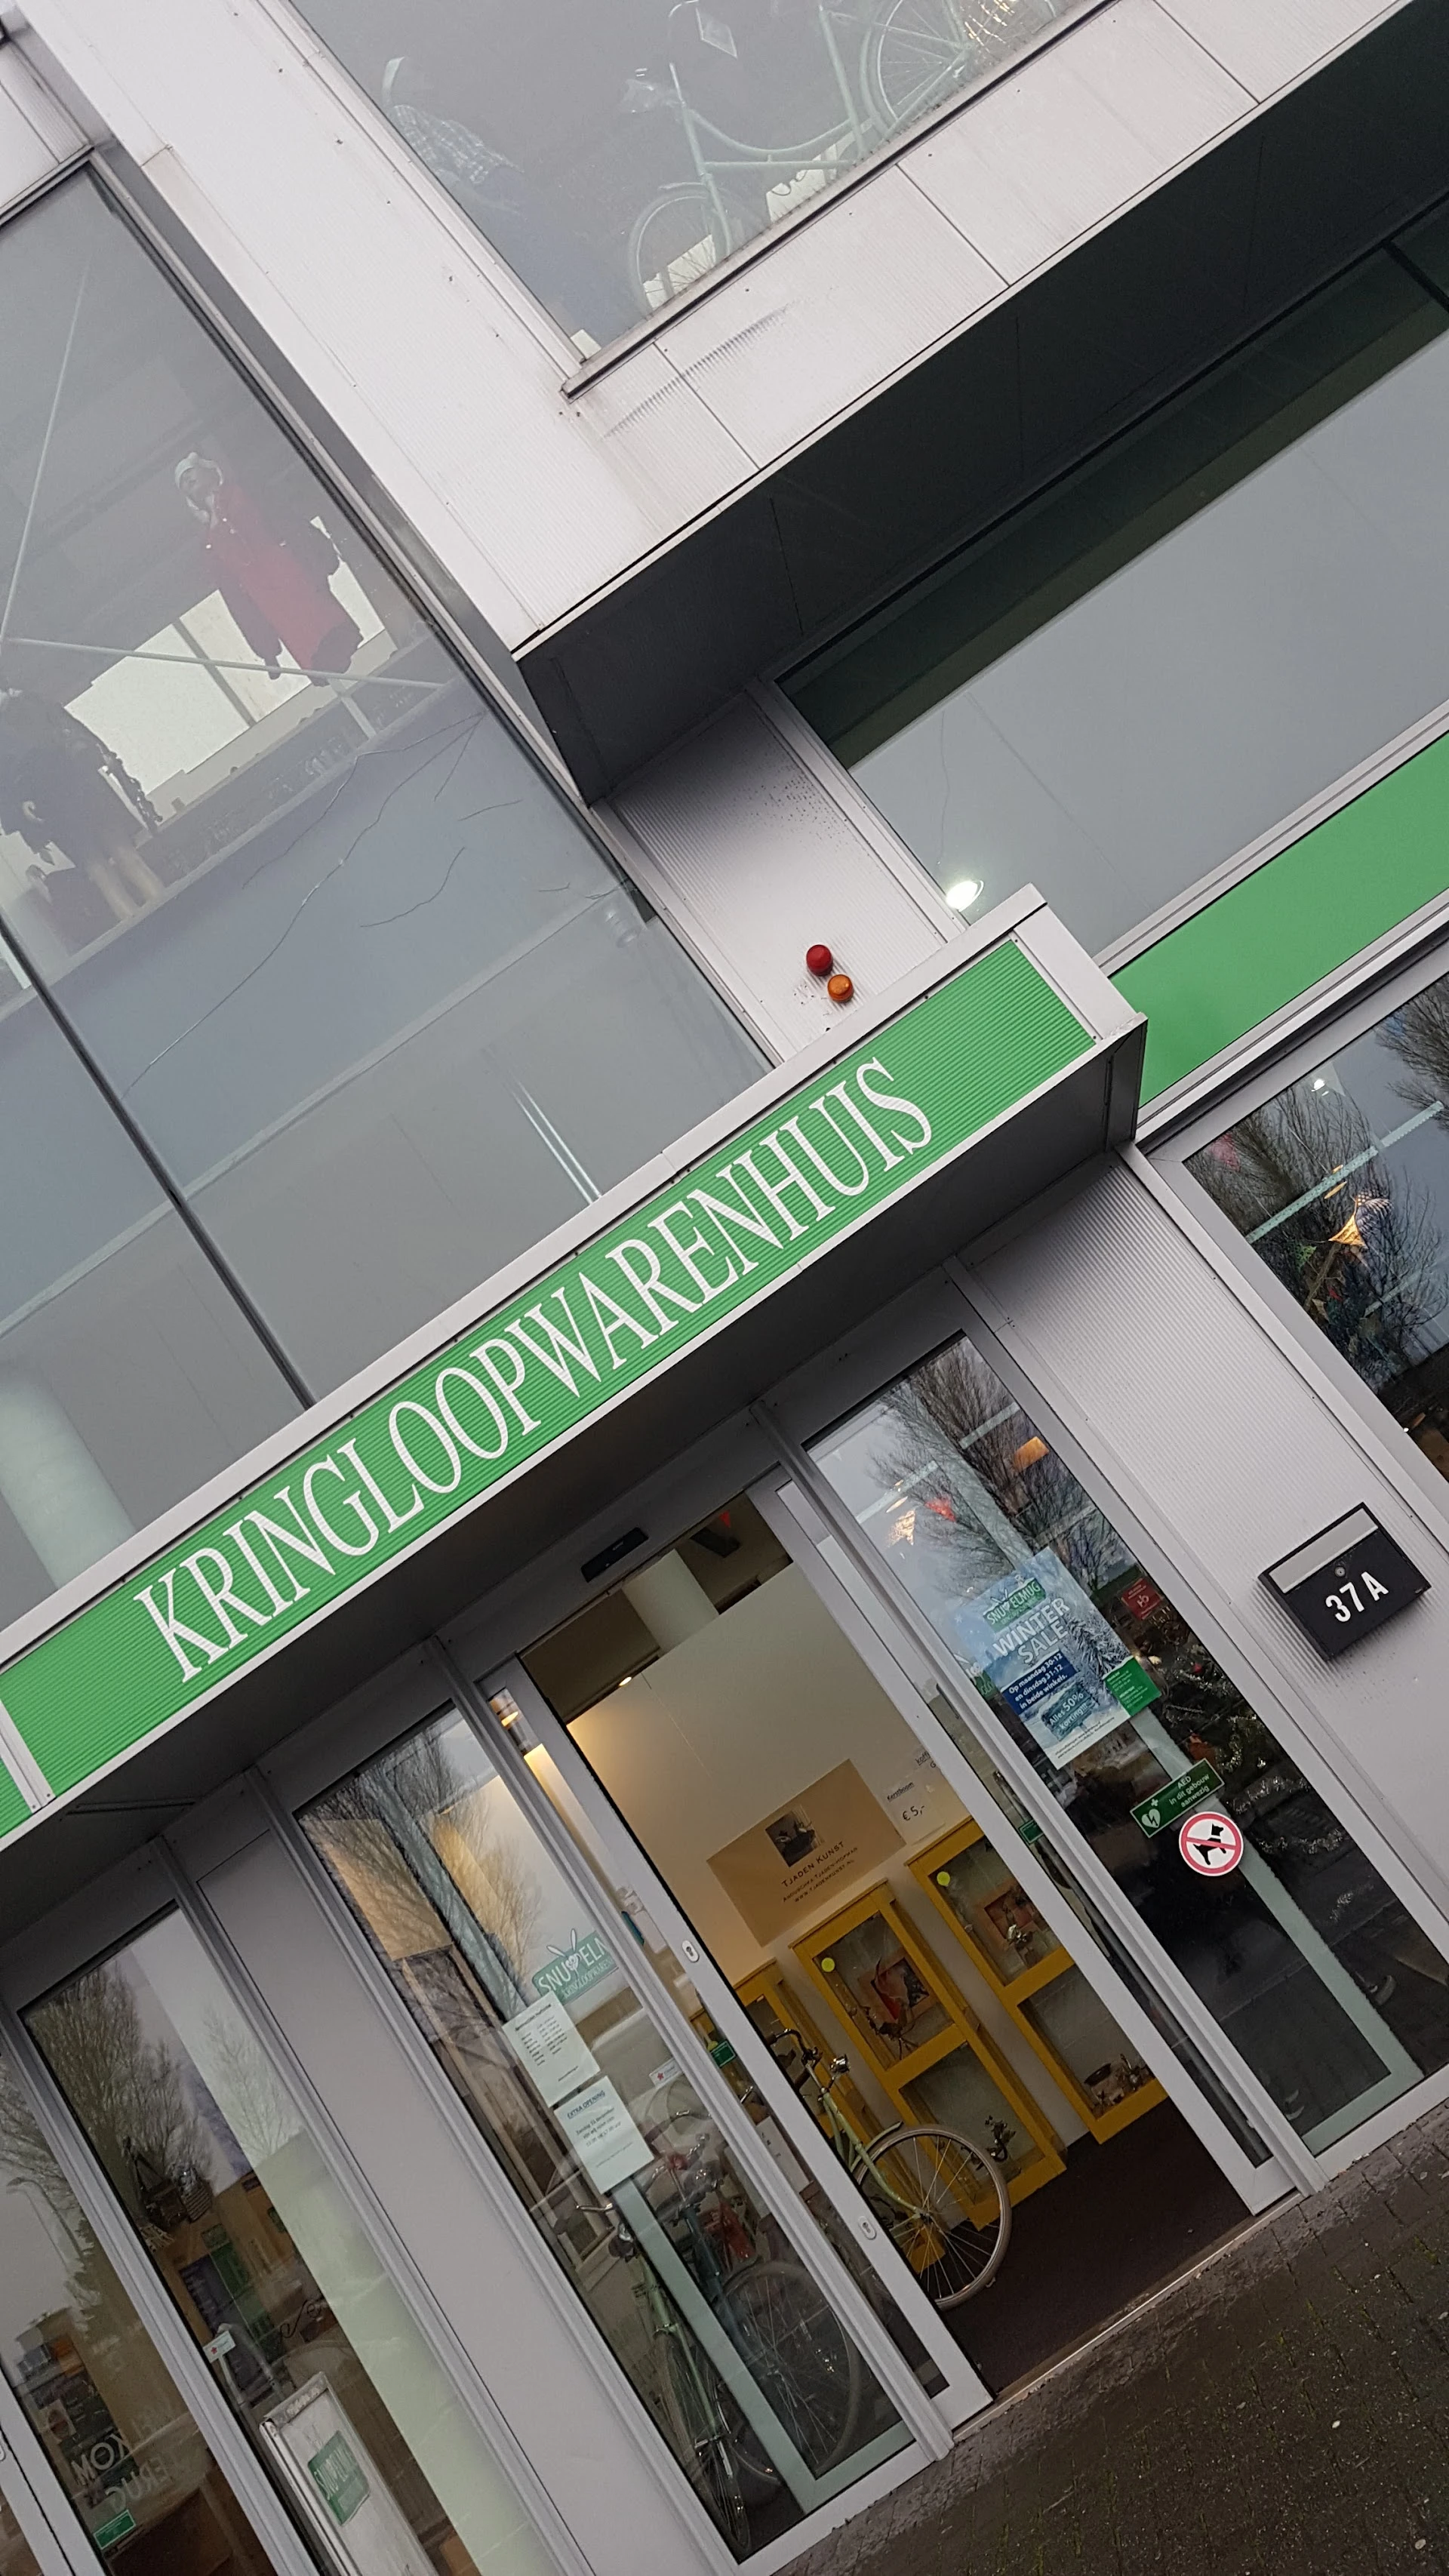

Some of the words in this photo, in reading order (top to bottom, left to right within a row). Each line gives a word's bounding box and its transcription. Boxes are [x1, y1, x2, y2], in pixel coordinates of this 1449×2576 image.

[133, 1057, 933, 1683] KRINGLOOPWARENHUIS
[992, 1597, 1070, 1657] WINTER
[1017, 1620, 1069, 1663] SALE
[1008, 1685, 1019, 1694] Op
[1018, 1666, 1046, 1688] maandag
[1044, 1652, 1063, 1668] 30-12
[1015, 1692, 1023, 1702] en
[1023, 1676, 1048, 1696] dinsdag
[1045, 1664, 1063, 1679] 31-12
[1026, 1689, 1044, 1705] beide
[1043, 1673, 1068, 1693] winkels.
[1049, 1708, 1066, 1726] Alles
[1062, 1691, 1084, 1712] 50%
[1168, 1797, 1177, 1805] in
[1177, 1790, 1186, 1800] dit
[1186, 1774, 1210, 1795] gebouw
[1177, 1775, 1192, 1790] AED
[1180, 1785, 1210, 1808] aanwezig
[781, 1863, 814, 1888] TJADEN
[816, 1841, 844, 1864] KUNST
